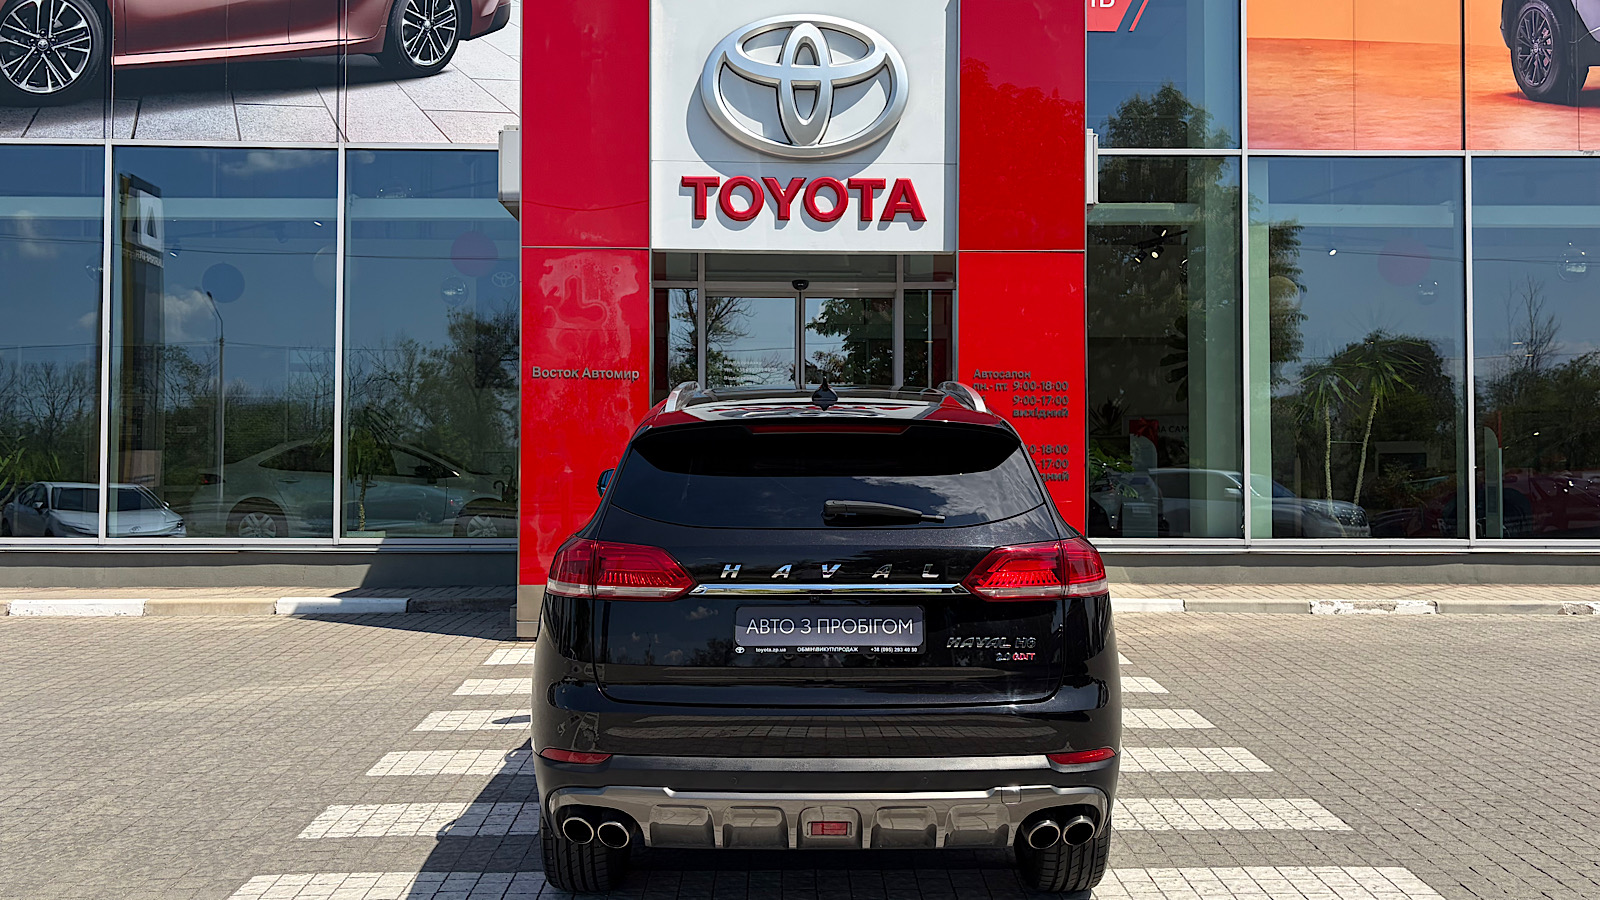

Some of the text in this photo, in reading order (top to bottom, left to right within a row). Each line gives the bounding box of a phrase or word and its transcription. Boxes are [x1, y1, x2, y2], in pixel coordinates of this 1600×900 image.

[681, 175, 927, 222] TOYOTA
[532, 366, 640, 382] Восток Автомир
[973, 368, 1031, 379] Автосалон
[1013, 381, 1069, 391] 9:00-18:00
[1013, 395, 1069, 405] 9:00-17:00
[1013, 407, 1069, 419] вихідний
[1025, 444, 1069, 454] 0-18:00
[1033, 459, 1069, 469] -17:00
[720, 563, 939, 579] HAVAL
[746, 618, 795, 634] АВТО
[817, 618, 913, 634] ПРОБІГОМ
[946, 637, 1036, 649] HAVAL H6
